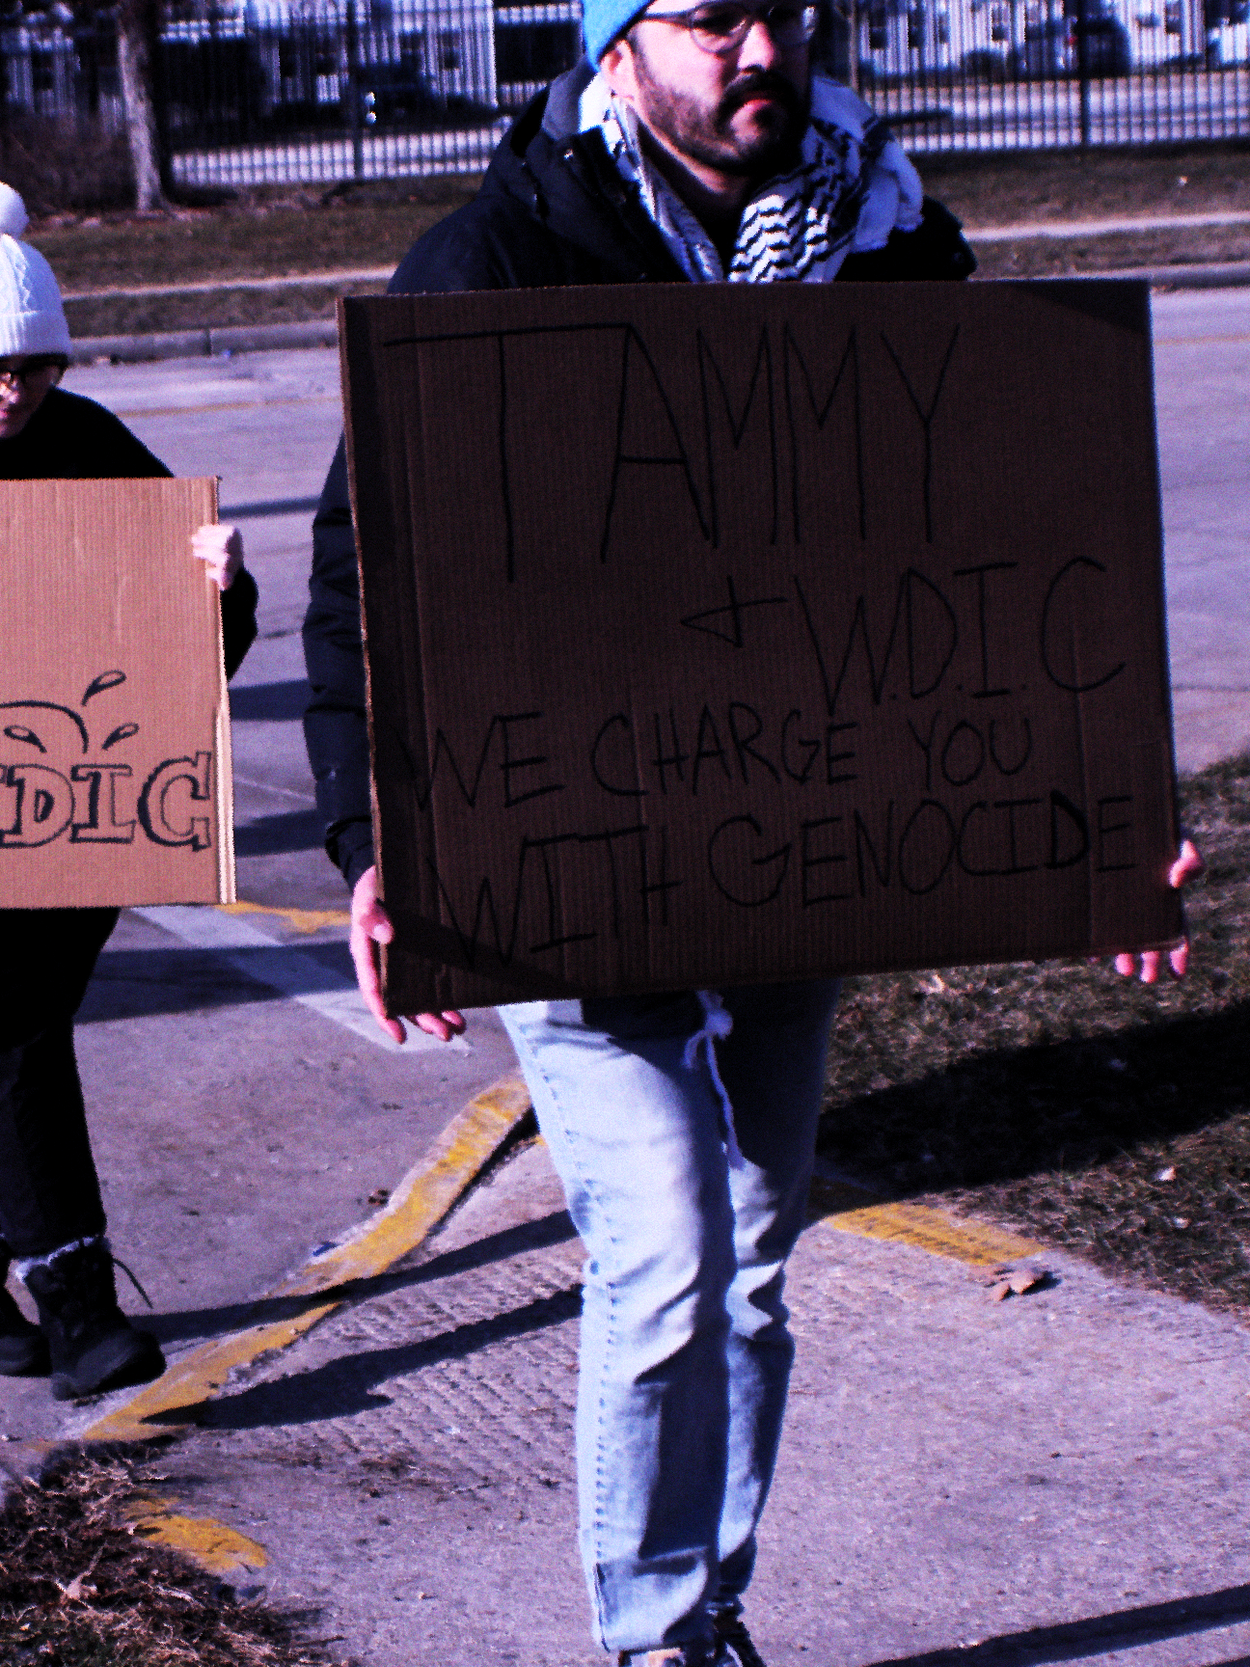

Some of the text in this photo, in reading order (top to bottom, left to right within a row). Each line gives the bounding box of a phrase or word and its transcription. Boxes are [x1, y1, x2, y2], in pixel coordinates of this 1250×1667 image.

[383, 322, 960, 582] TAMMY
[389, 700, 1033, 813] WE CHARGE YOU
[425, 789, 1136, 967] WITH GENOCIDE
